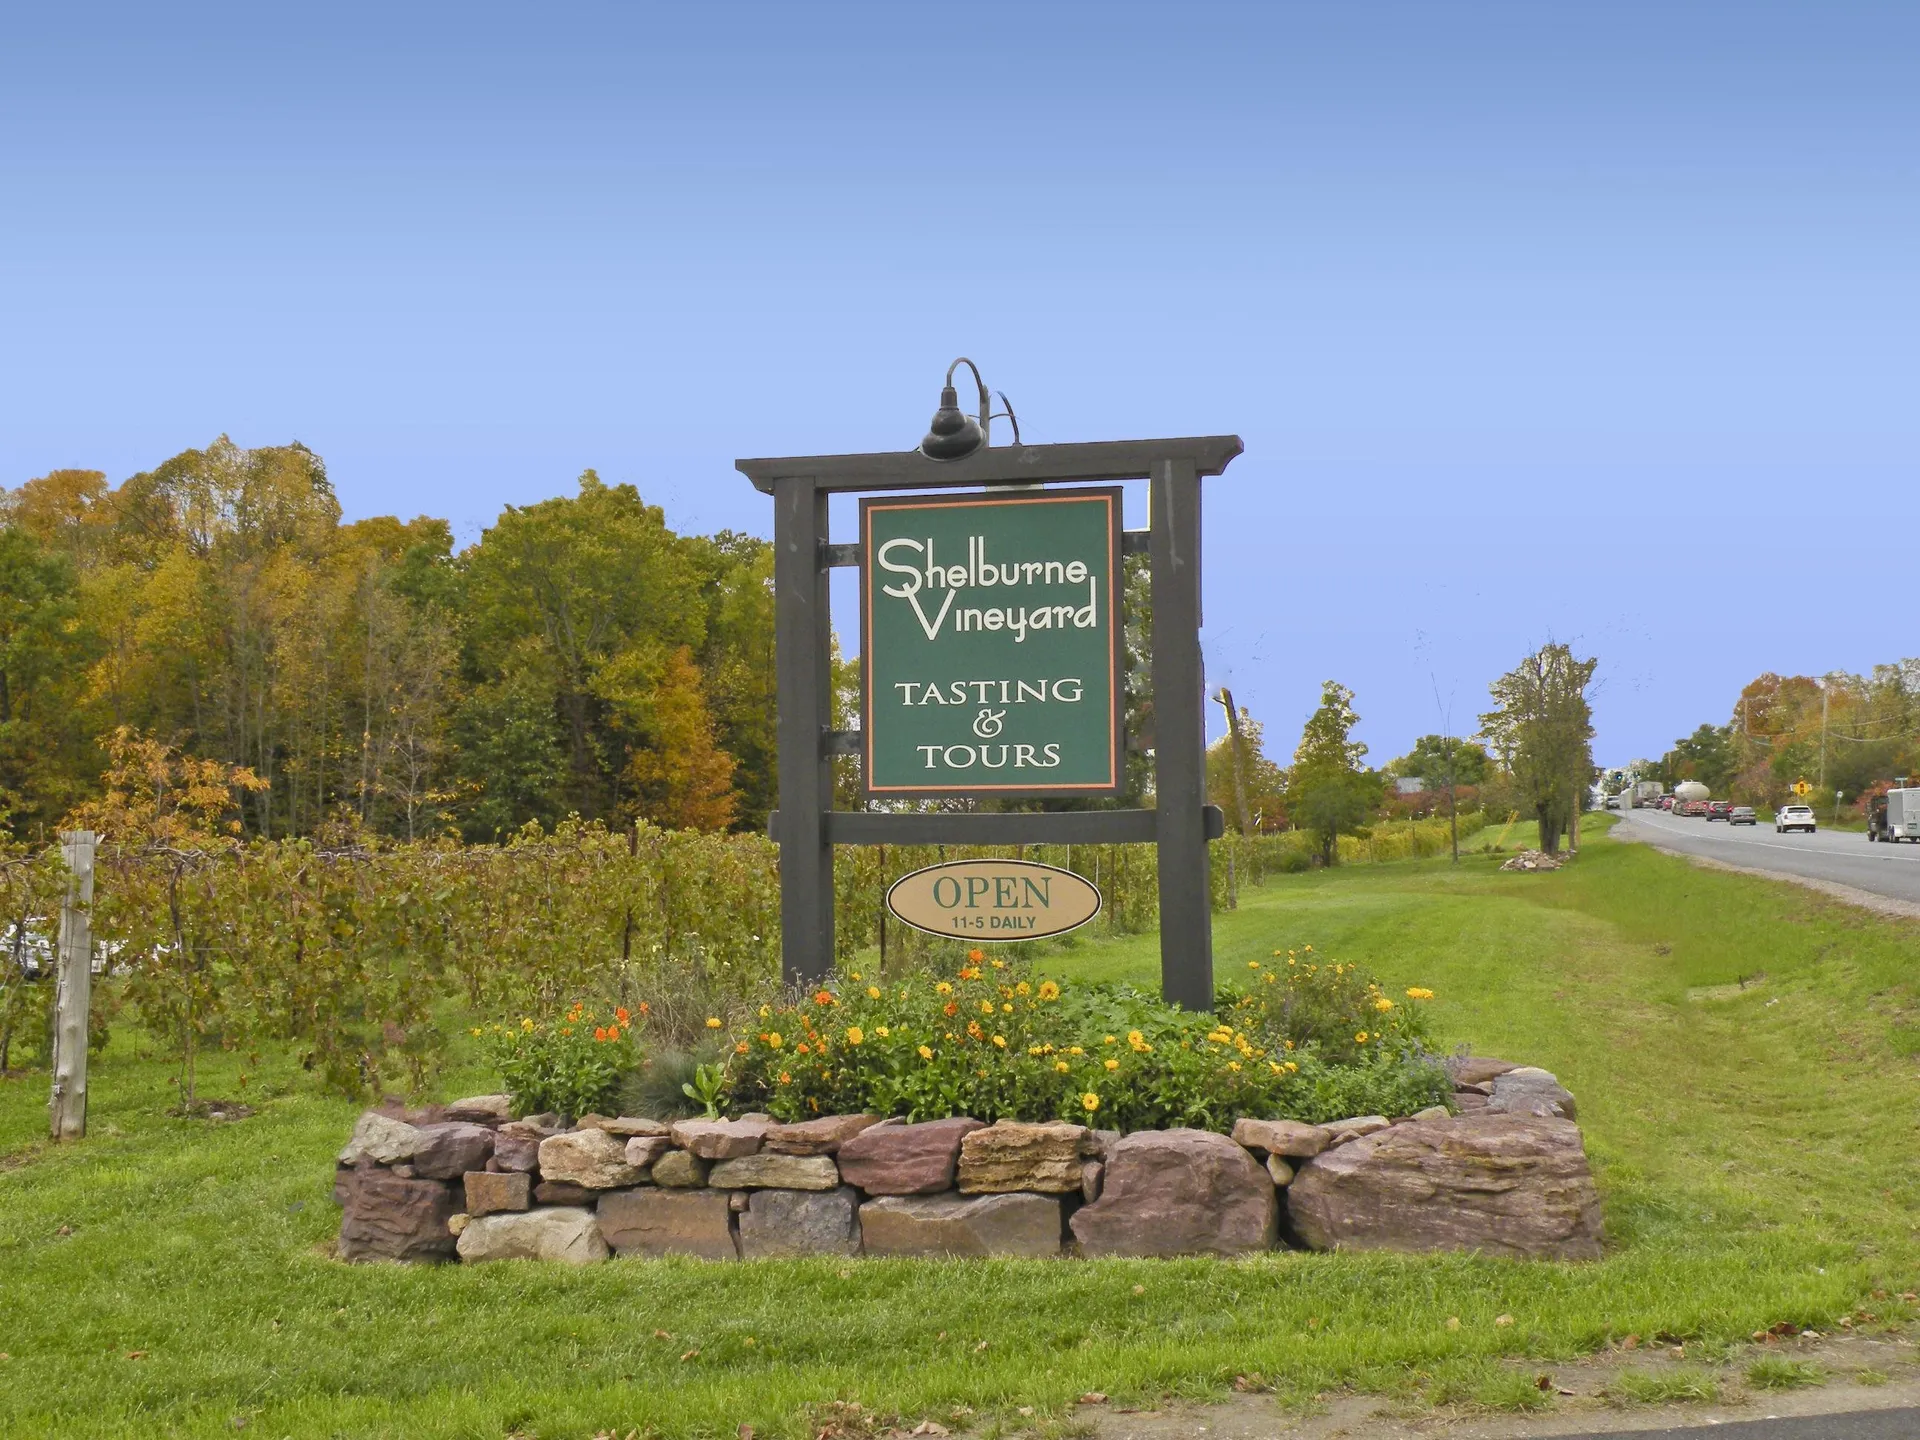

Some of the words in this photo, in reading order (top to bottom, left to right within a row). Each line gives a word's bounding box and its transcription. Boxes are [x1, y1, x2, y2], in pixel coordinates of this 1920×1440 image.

[877, 535, 1088, 598] Shelburne
[902, 576, 1097, 643] Vineyard
[894, 678, 1084, 706] TASTING
[972, 708, 1007, 739] &
[916, 743, 1061, 769] TOURS
[932, 876, 1052, 909] OPEN
[951, 916, 984, 929] 11-5
[990, 916, 1037, 929] DAILY
